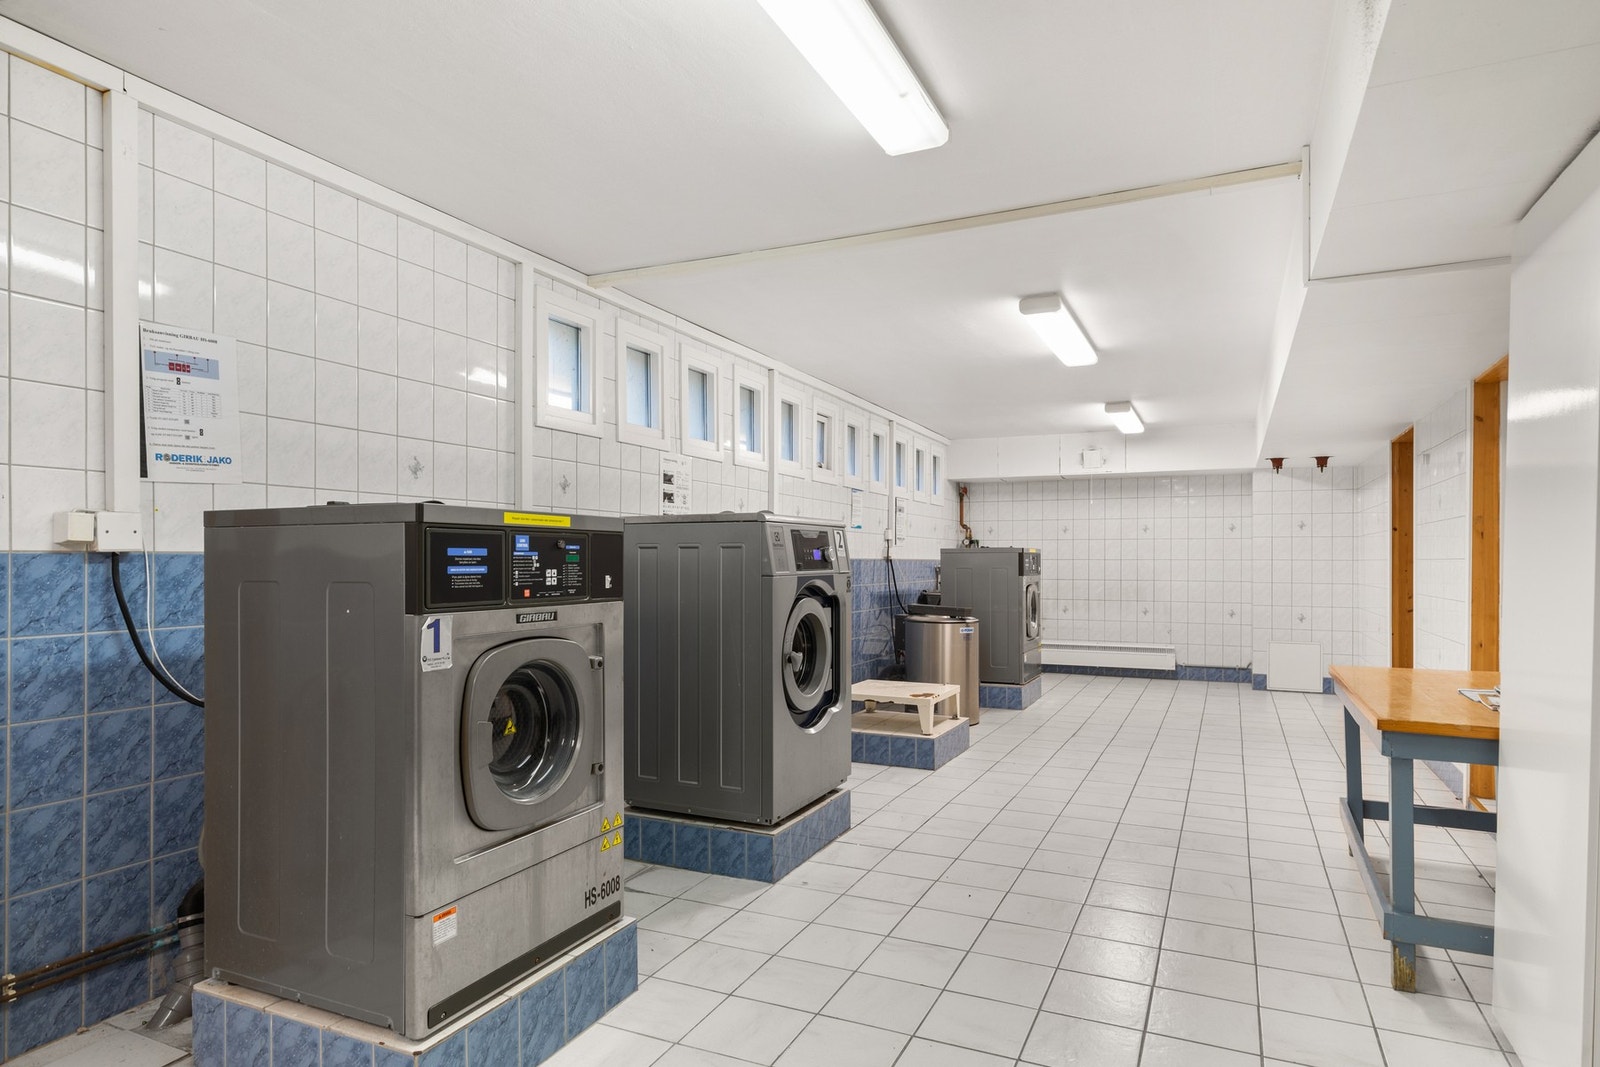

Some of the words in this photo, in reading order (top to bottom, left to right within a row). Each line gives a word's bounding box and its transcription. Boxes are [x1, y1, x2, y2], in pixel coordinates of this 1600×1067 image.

[206, 456, 232, 465] JAKO
[836, 531, 844, 548] 2
[520, 612, 556, 622] GIRBAU
[427, 618, 441, 653] 1
[584, 874, 620, 909] HS-6008
